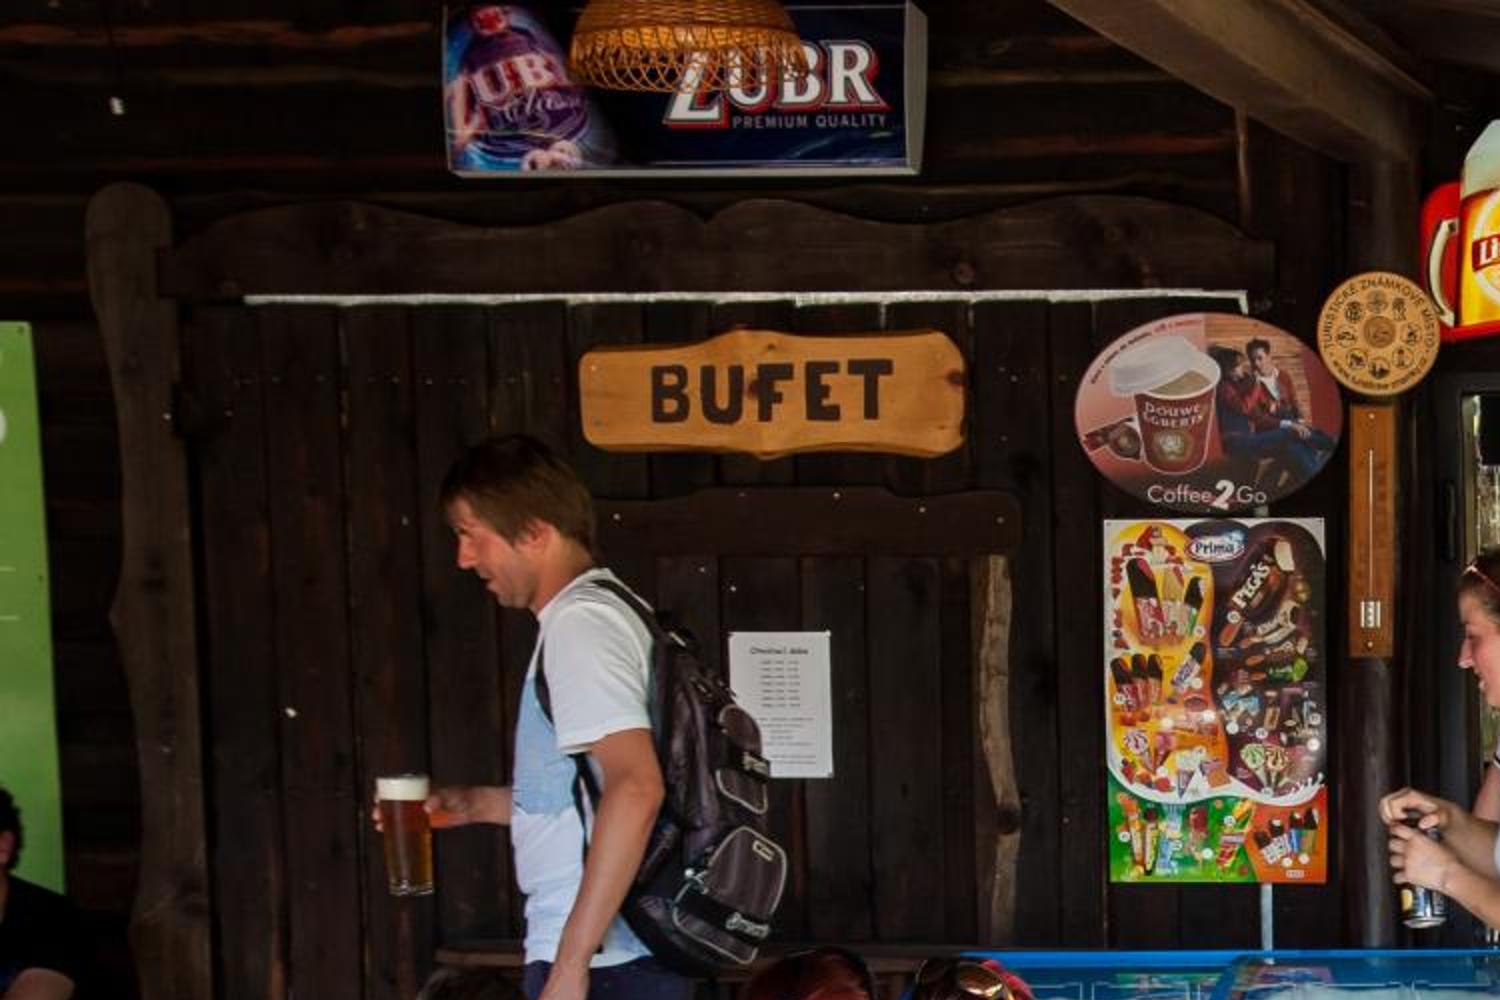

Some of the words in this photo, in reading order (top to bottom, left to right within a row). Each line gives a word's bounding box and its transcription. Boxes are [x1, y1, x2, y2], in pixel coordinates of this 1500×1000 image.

[732, 115, 808, 129] PREMIUM
[815, 115, 887, 129] QUALITY
[650, 358, 893, 425] BUFET
